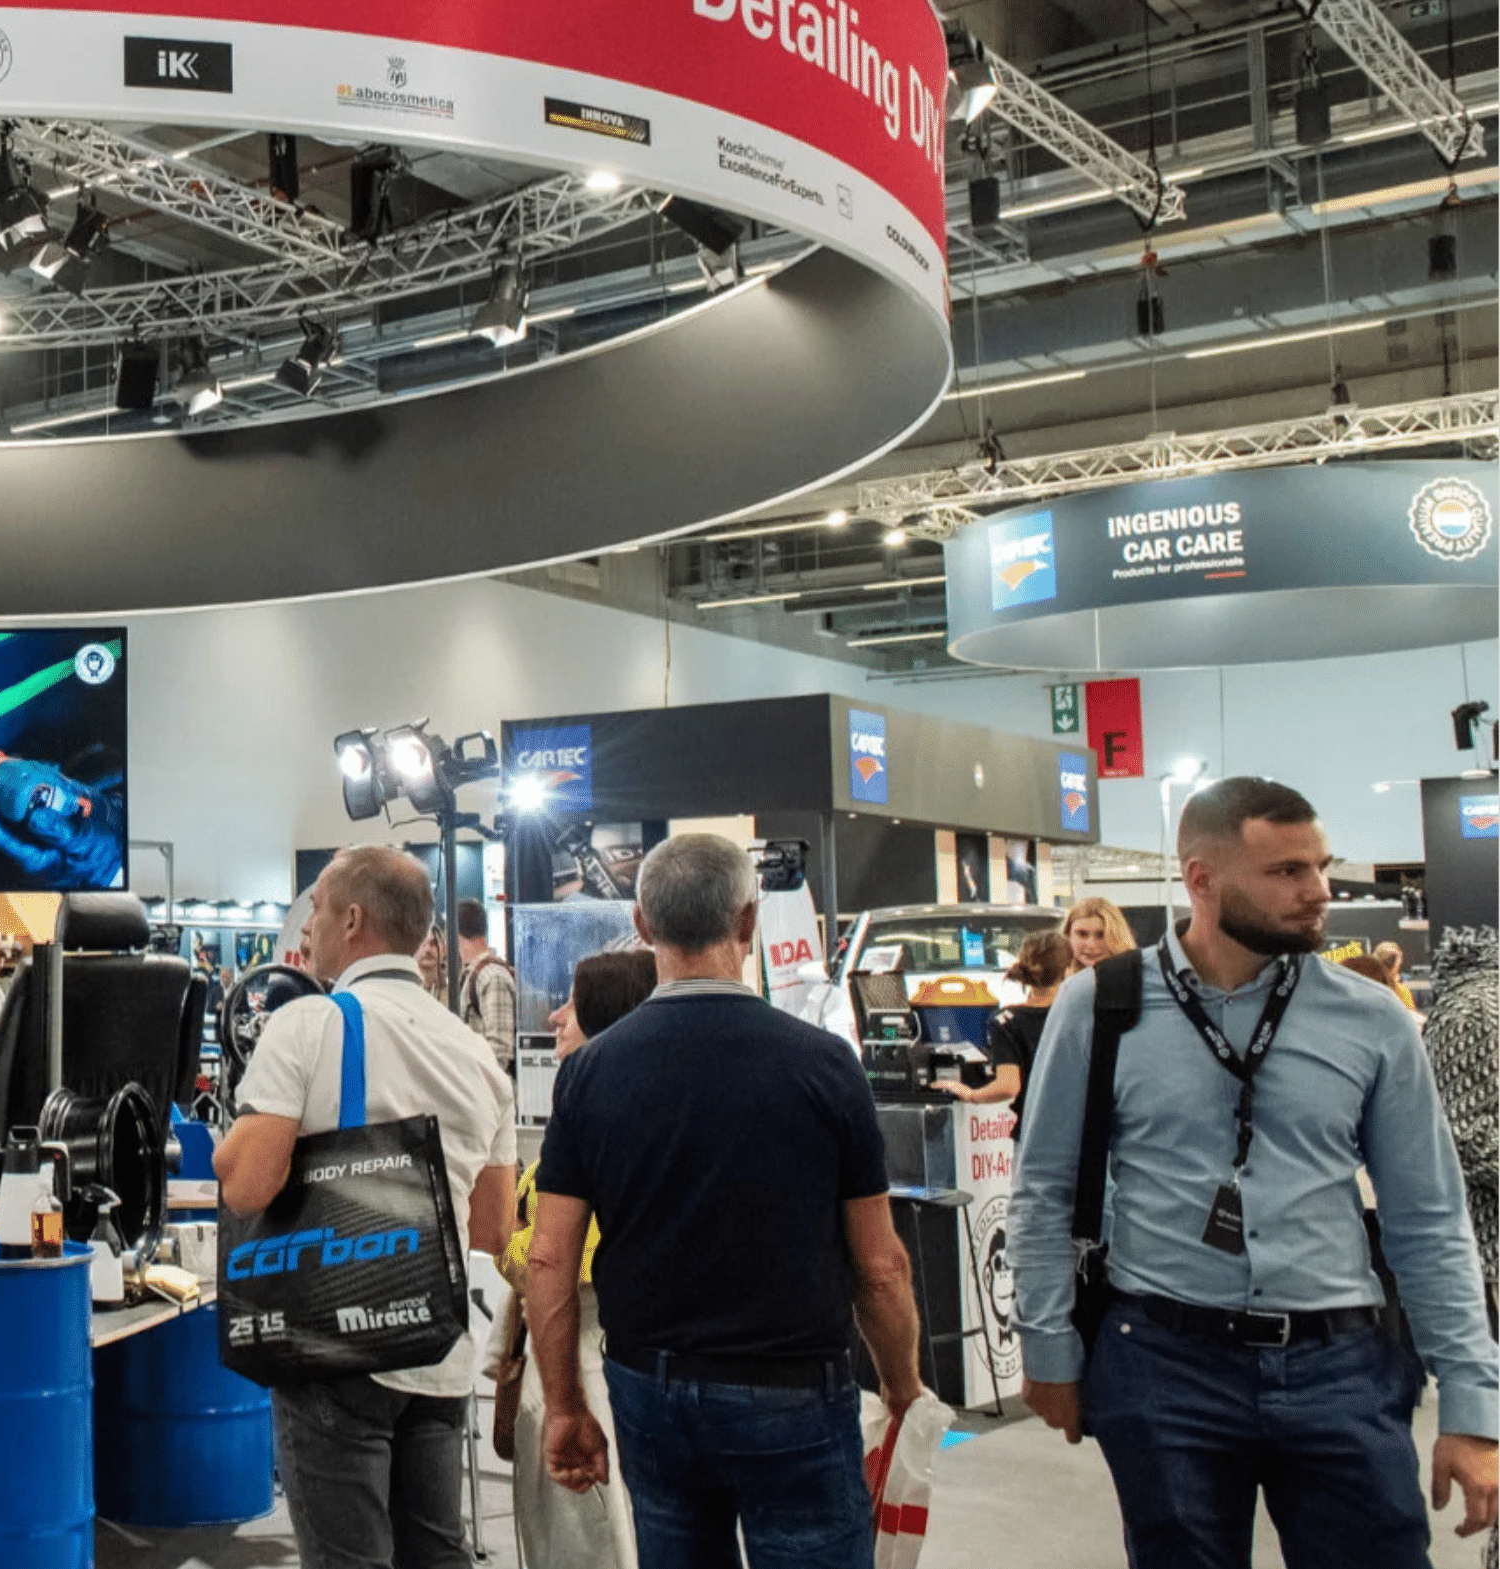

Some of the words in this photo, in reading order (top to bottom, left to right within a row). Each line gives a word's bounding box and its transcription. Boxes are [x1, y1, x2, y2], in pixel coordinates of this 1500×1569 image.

[693, 0, 899, 140] etailing
[1107, 502, 1241, 538] INGENIOUS
[1123, 537, 1171, 563] CAR
[1176, 530, 1244, 557] CARE
[1113, 565, 1156, 579] Products
[1157, 563, 1171, 574] for
[1174, 557, 1245, 573] professionals
[517, 746, 588, 769] CARTEC
[1103, 731, 1128, 768] F
[969, 1111, 1016, 1143] Detailin
[302, 1165, 348, 1184] BODY
[351, 1154, 413, 1176] REPAIR
[971, 1151, 1011, 1181] DIY-Ar
[228, 1315, 255, 1339] 25
[260, 1311, 286, 1333] 15
[336, 1305, 432, 1334] Miracle
